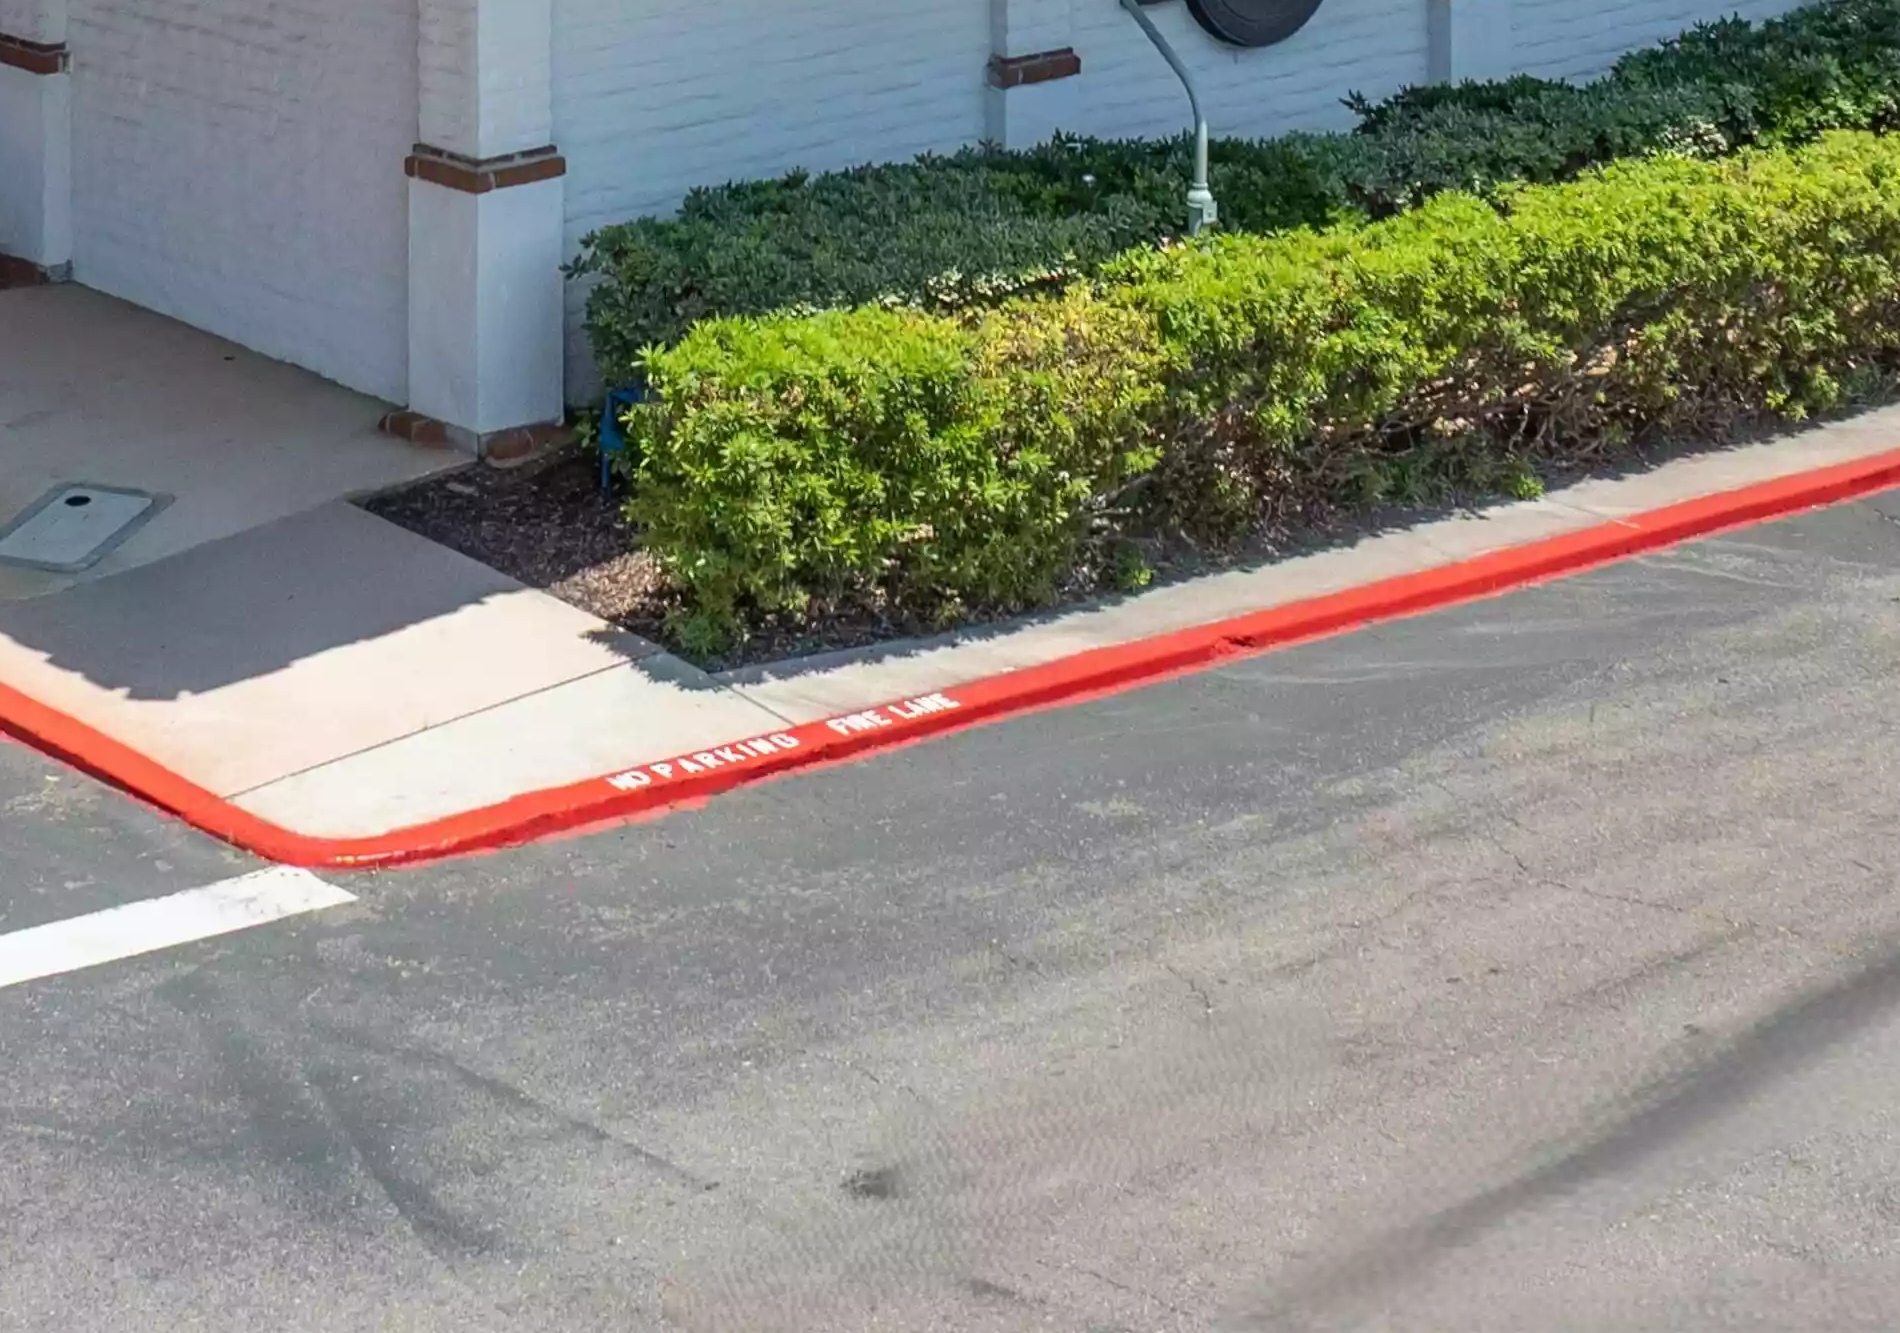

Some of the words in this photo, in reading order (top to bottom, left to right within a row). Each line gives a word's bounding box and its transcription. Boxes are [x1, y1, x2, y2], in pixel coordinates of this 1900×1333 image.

[605, 770, 651, 791] NO
[650, 733, 800, 779] PARKING
[887, 692, 961, 719] LANE
